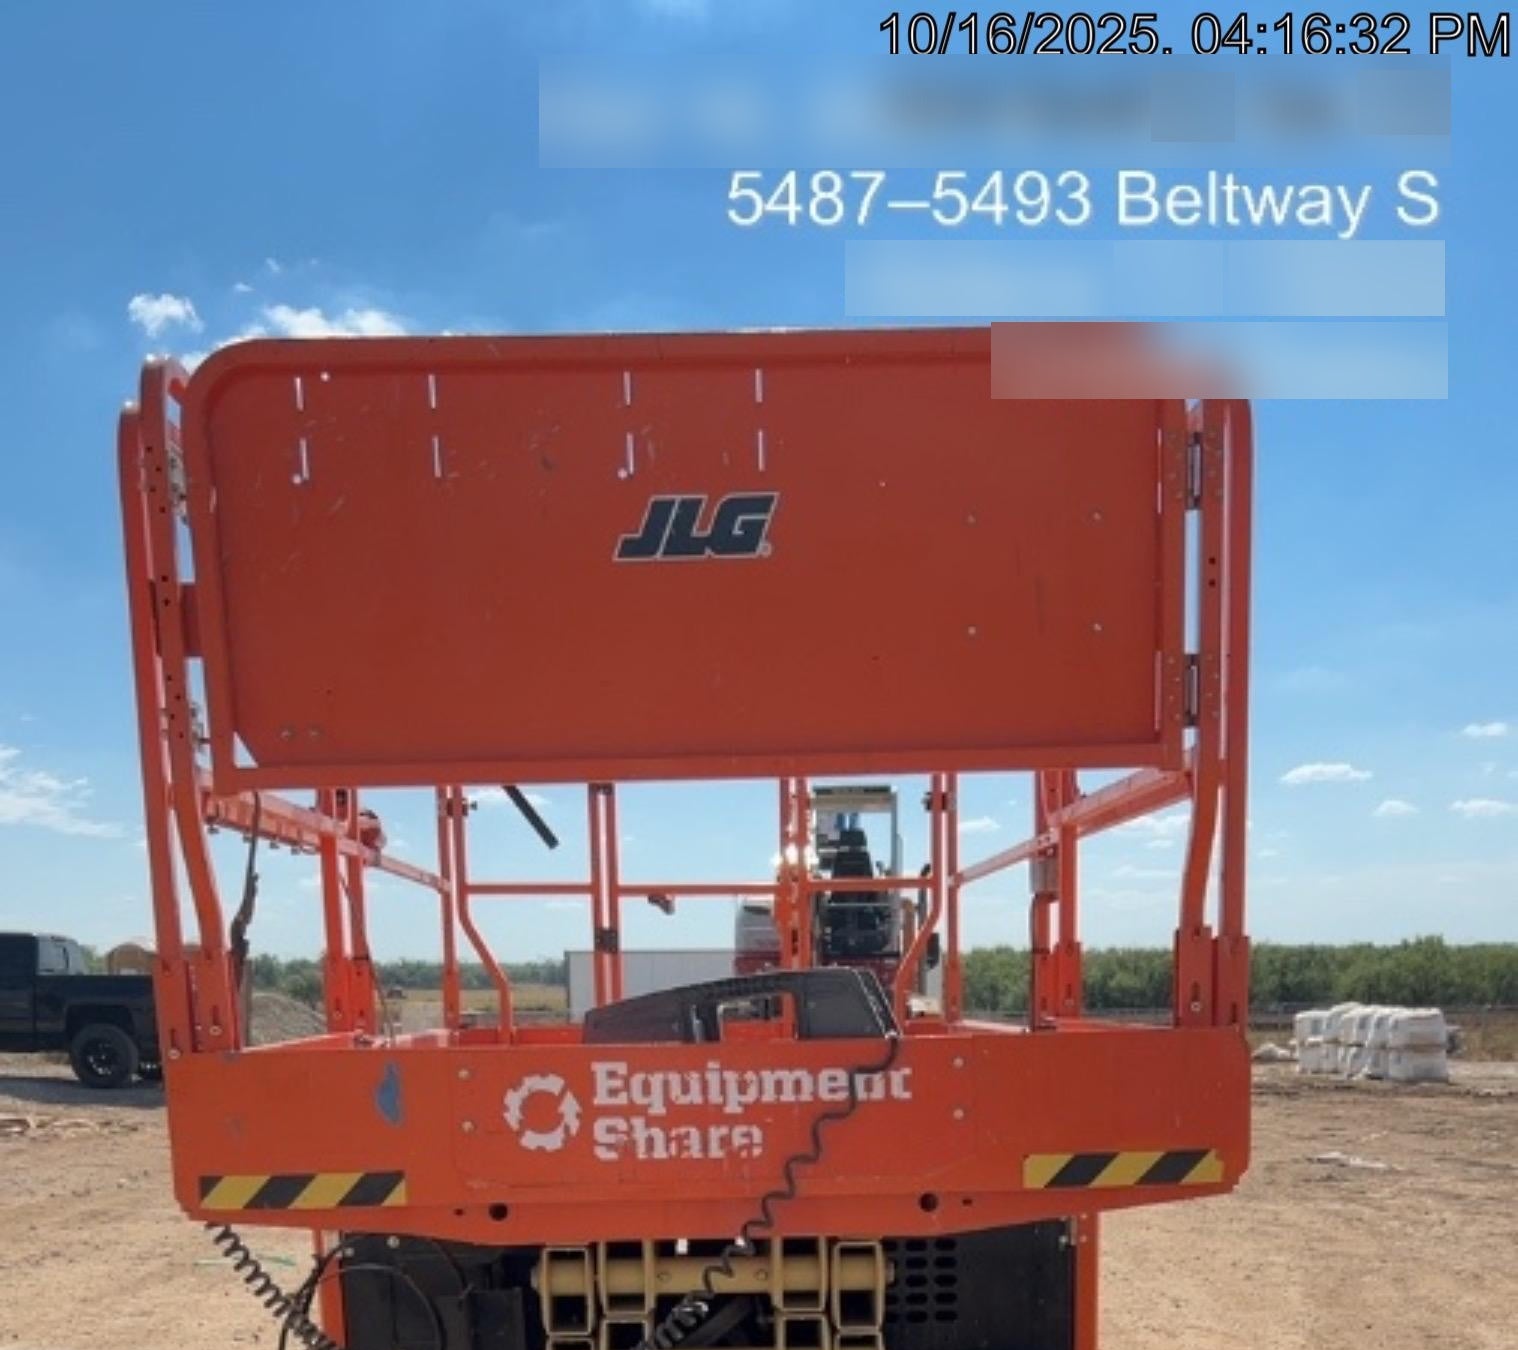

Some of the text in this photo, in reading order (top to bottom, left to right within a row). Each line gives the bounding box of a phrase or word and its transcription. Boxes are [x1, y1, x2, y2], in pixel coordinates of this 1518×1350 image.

[612, 491, 780, 562] JLG
[590, 1061, 913, 1116] Equipment
[592, 1115, 764, 1160] Share
